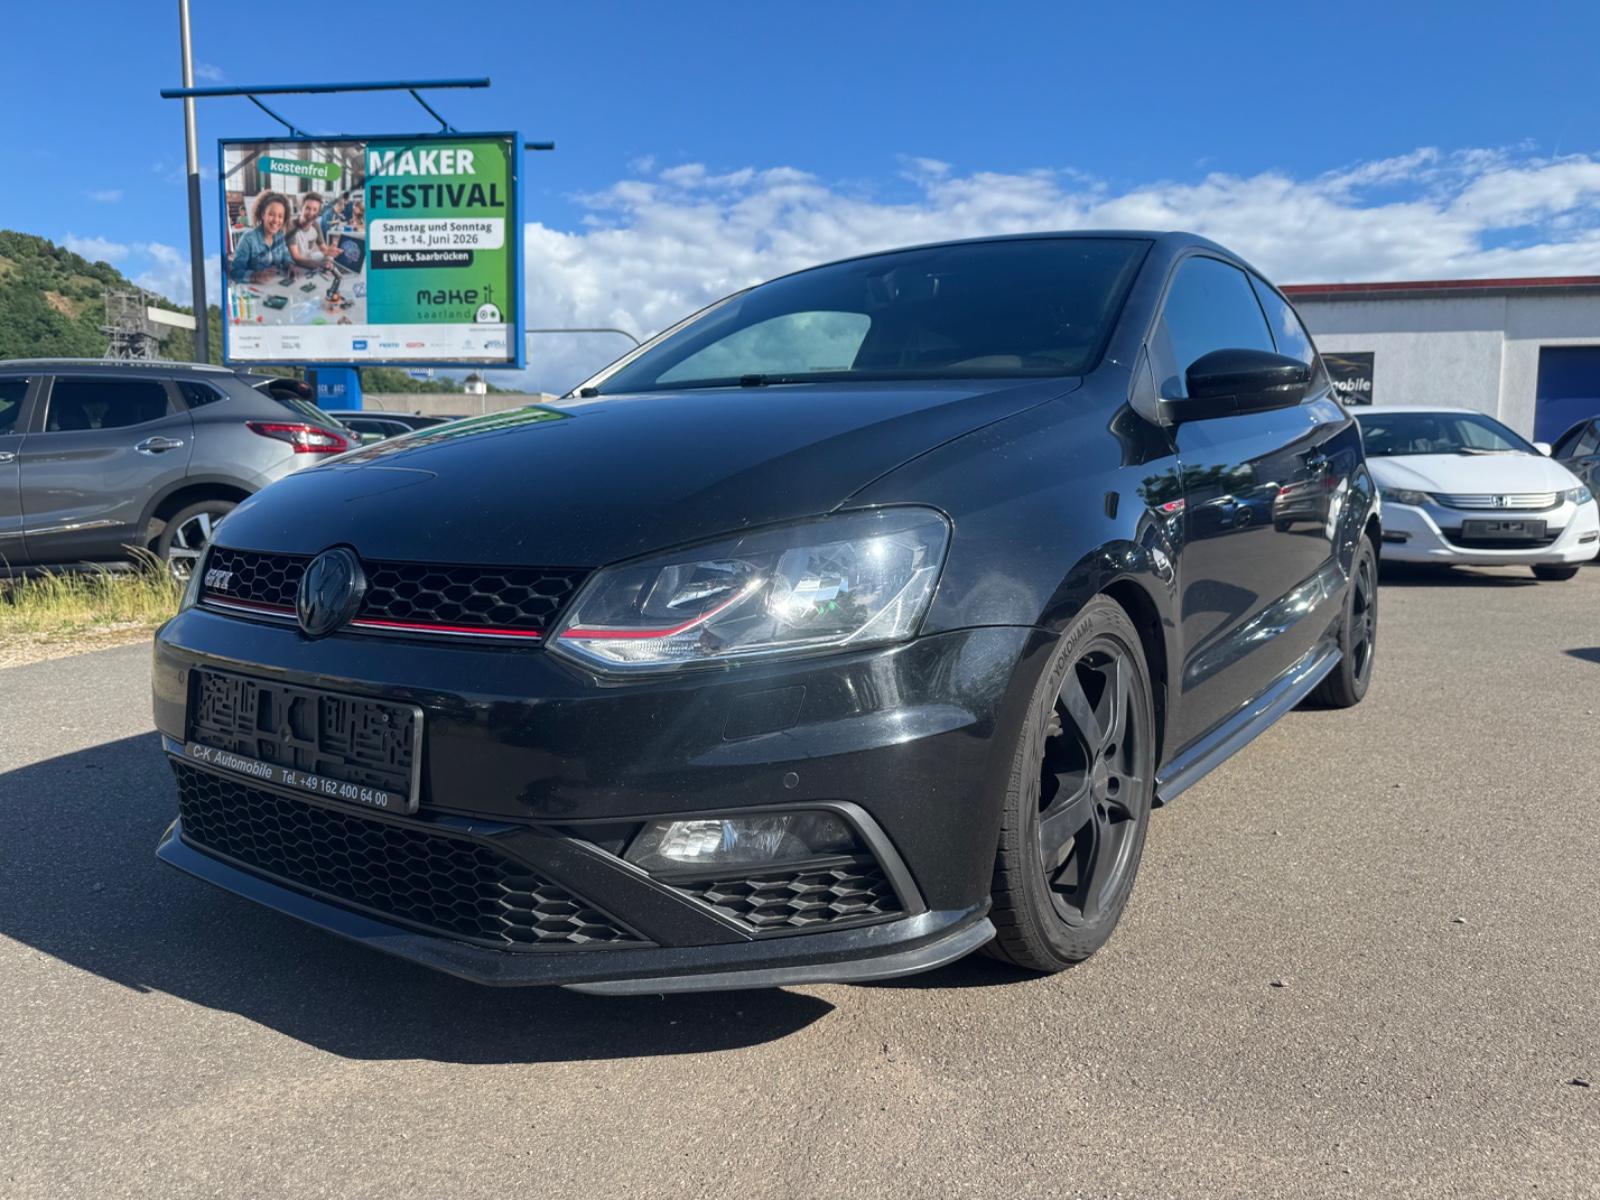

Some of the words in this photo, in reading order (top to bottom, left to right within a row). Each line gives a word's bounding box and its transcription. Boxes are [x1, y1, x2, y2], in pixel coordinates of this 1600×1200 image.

[270, 160, 328, 177] kostenfrei
[370, 149, 475, 176] MAKER
[370, 184, 504, 209] FESTIVAL
[383, 222, 426, 233] Samstag
[428, 222, 447, 232] und
[450, 222, 492, 233] Sonntag
[384, 235, 398, 245] 13.
[411, 235, 425, 245] 14.
[428, 234, 450, 246] Juni
[453, 234, 478, 244] 2026
[383, 254, 389, 263] E
[390, 253, 413, 264] Werk,
[416, 251, 468, 262] Saarbrücken
[417, 309, 471, 320] saarland
[205, 568, 233, 589] GTI
[1053, 617, 1095, 677] YOKOHAMA
[193, 745, 211, 760] C-K
[214, 751, 273, 779] Automobile
[282, 770, 297, 785] Tel.
[300, 776, 318, 790] +49
[320, 779, 338, 794] 162
[339, 784, 358, 799] 400
[360, 788, 373, 803] 64
[375, 791, 388, 807] 00
